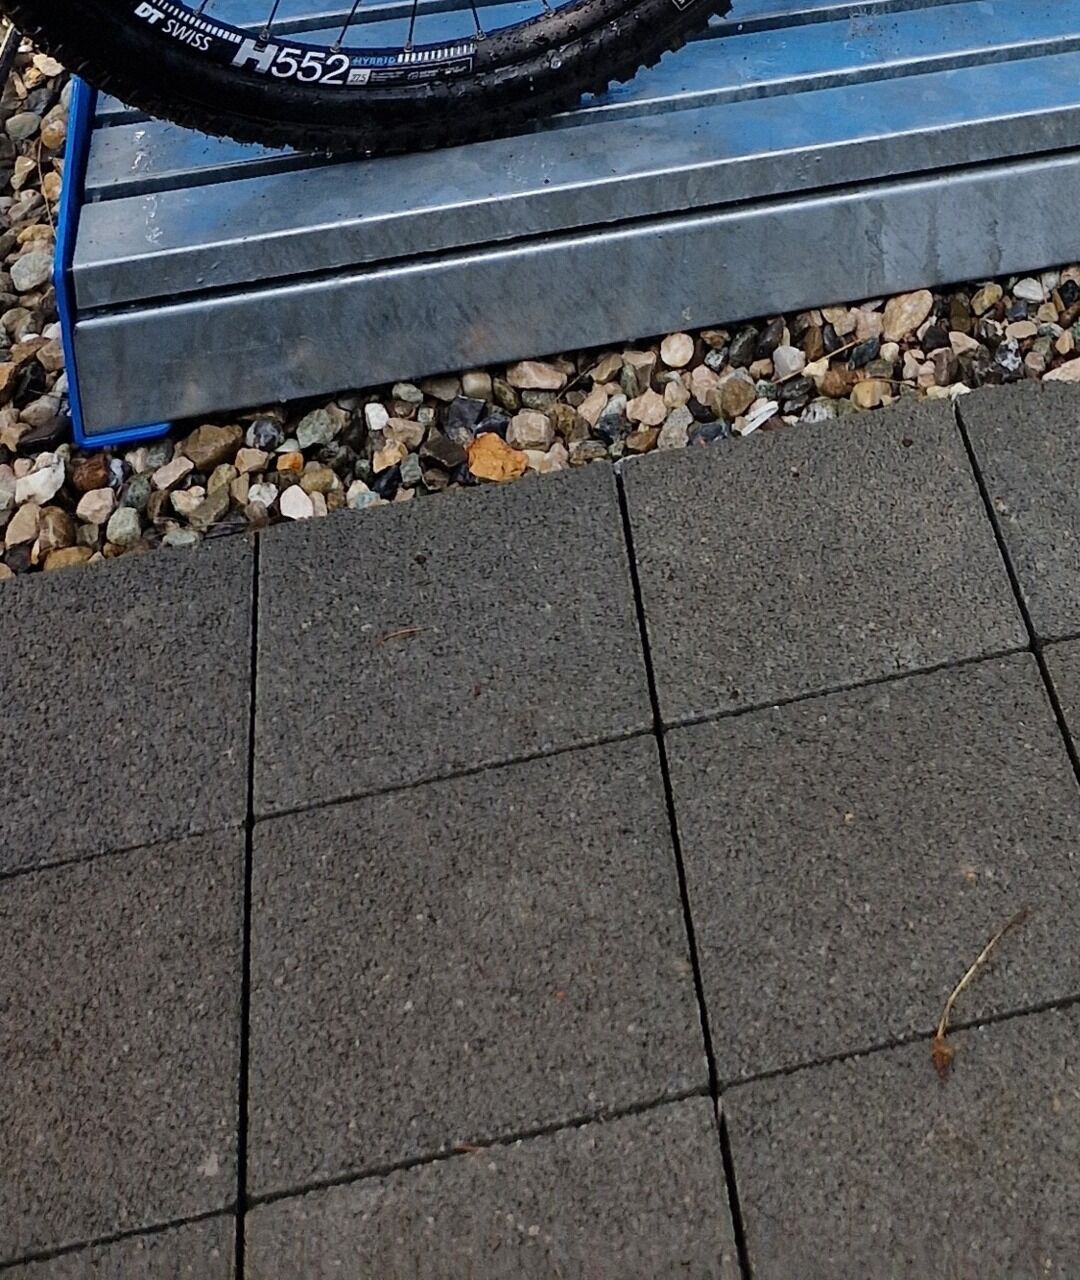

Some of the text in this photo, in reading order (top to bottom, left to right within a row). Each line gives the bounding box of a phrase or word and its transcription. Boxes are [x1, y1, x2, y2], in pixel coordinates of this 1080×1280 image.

[134, 1, 166, 25] DT
[161, 18, 213, 52] SWISS
[231, 38, 350, 85] H552
